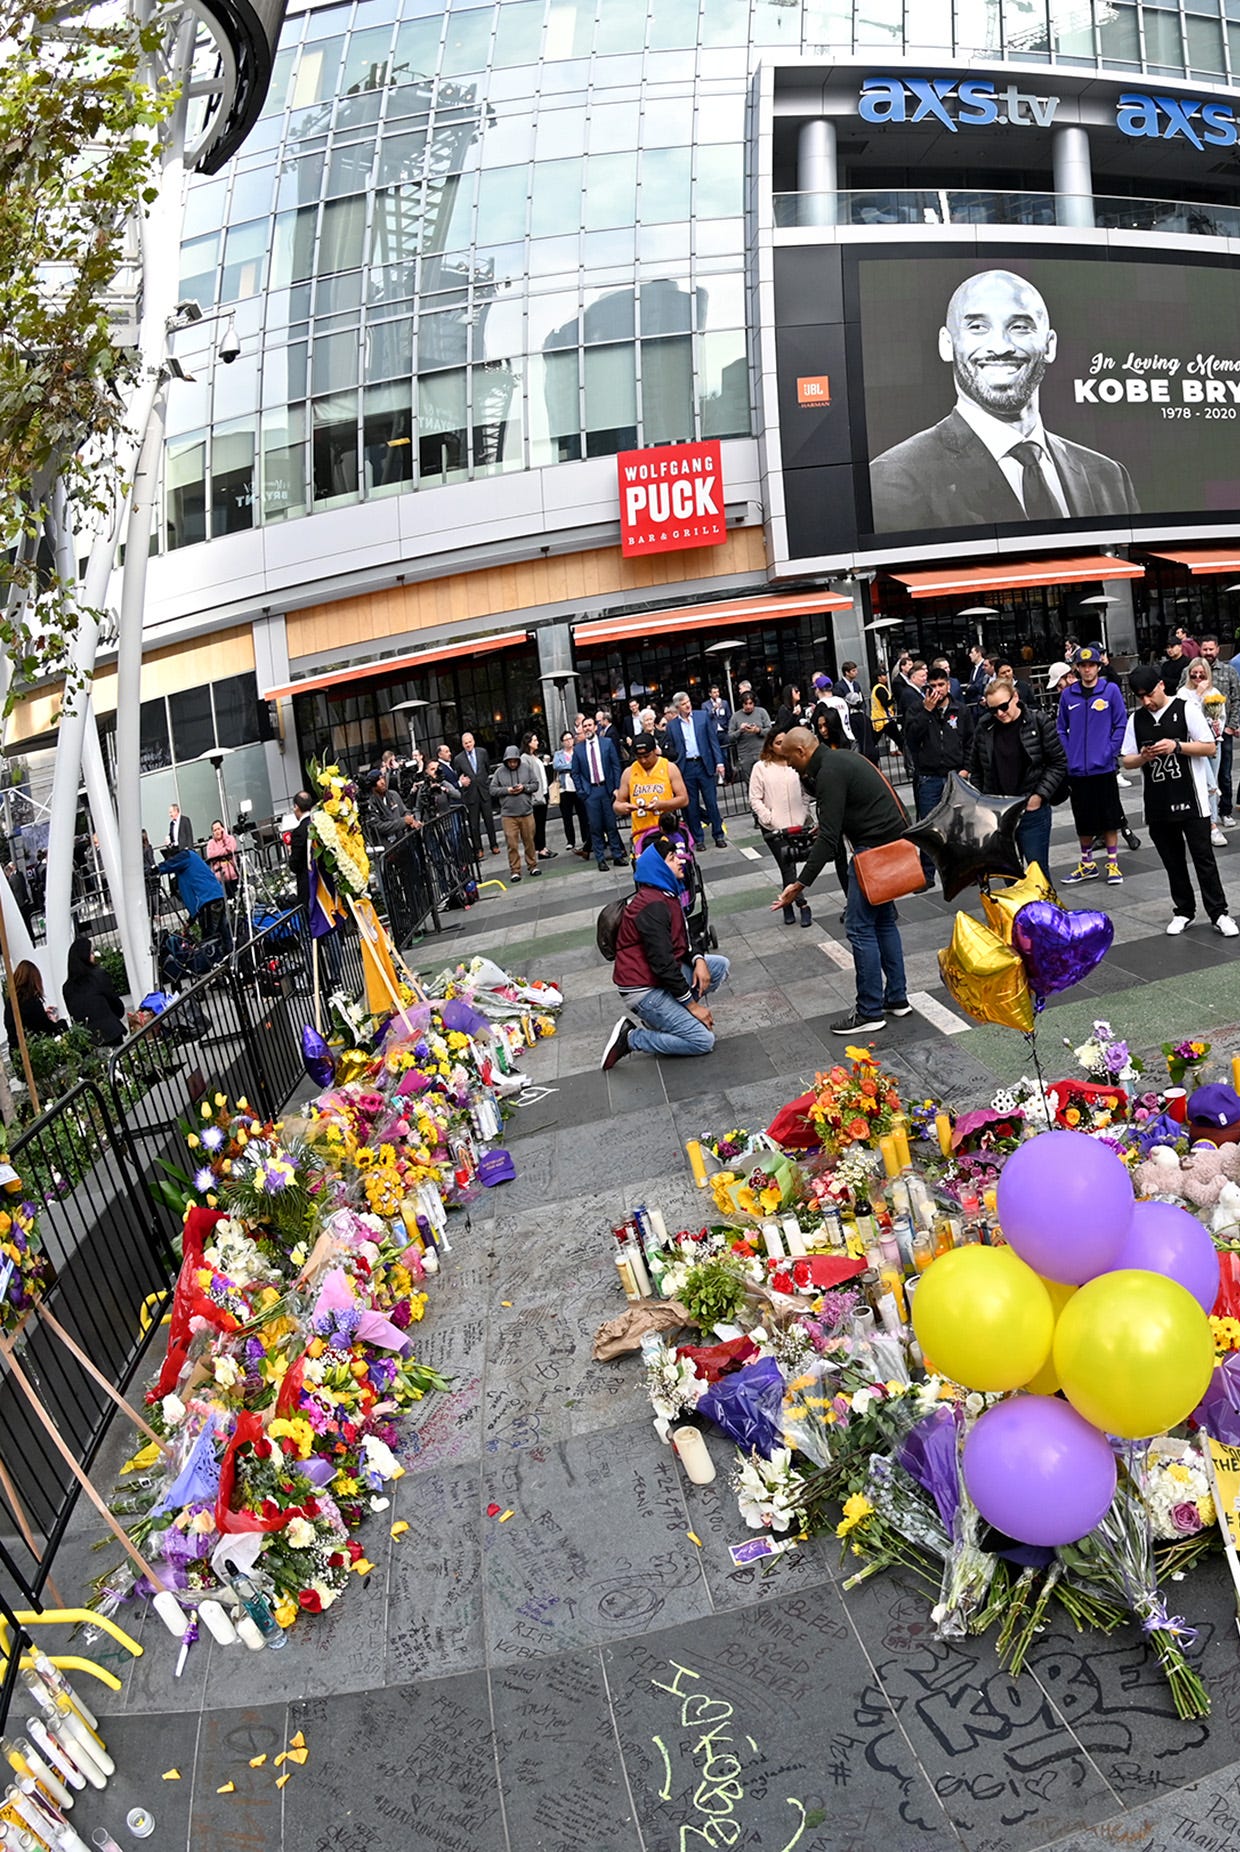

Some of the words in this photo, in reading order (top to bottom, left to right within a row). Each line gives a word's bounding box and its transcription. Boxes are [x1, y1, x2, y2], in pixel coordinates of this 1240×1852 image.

[858, 76, 1059, 133] axs.tv
[1089, 353, 1116, 375] In
[1122, 352, 1181, 376] Loving
[803, 383, 824, 397] JBL
[1073, 378, 1170, 404] KOBE
[1161, 407, 1192, 419] 1978
[1205, 408, 1237, 419] 2020
[624, 456, 714, 482] WOLFGANG
[625, 476, 719, 527] PUCK
[628, 533, 657, 545] BAR
[672, 525, 720, 539] GRILL
[1150, 753, 1182, 782] 24
[633, 784, 664, 797] LAKERS
[649, 1461, 680, 1494] #24
[1213, 1457, 1240, 1472] THE
[660, 1507, 688, 1536] #8
[783, 1600, 848, 1640] BLEED
[624, 1646, 667, 1672] RIP
[716, 1643, 813, 1697] FOREVER
[757, 1642, 810, 1675] GOLD
[915, 1644, 1186, 1757] KOBE
